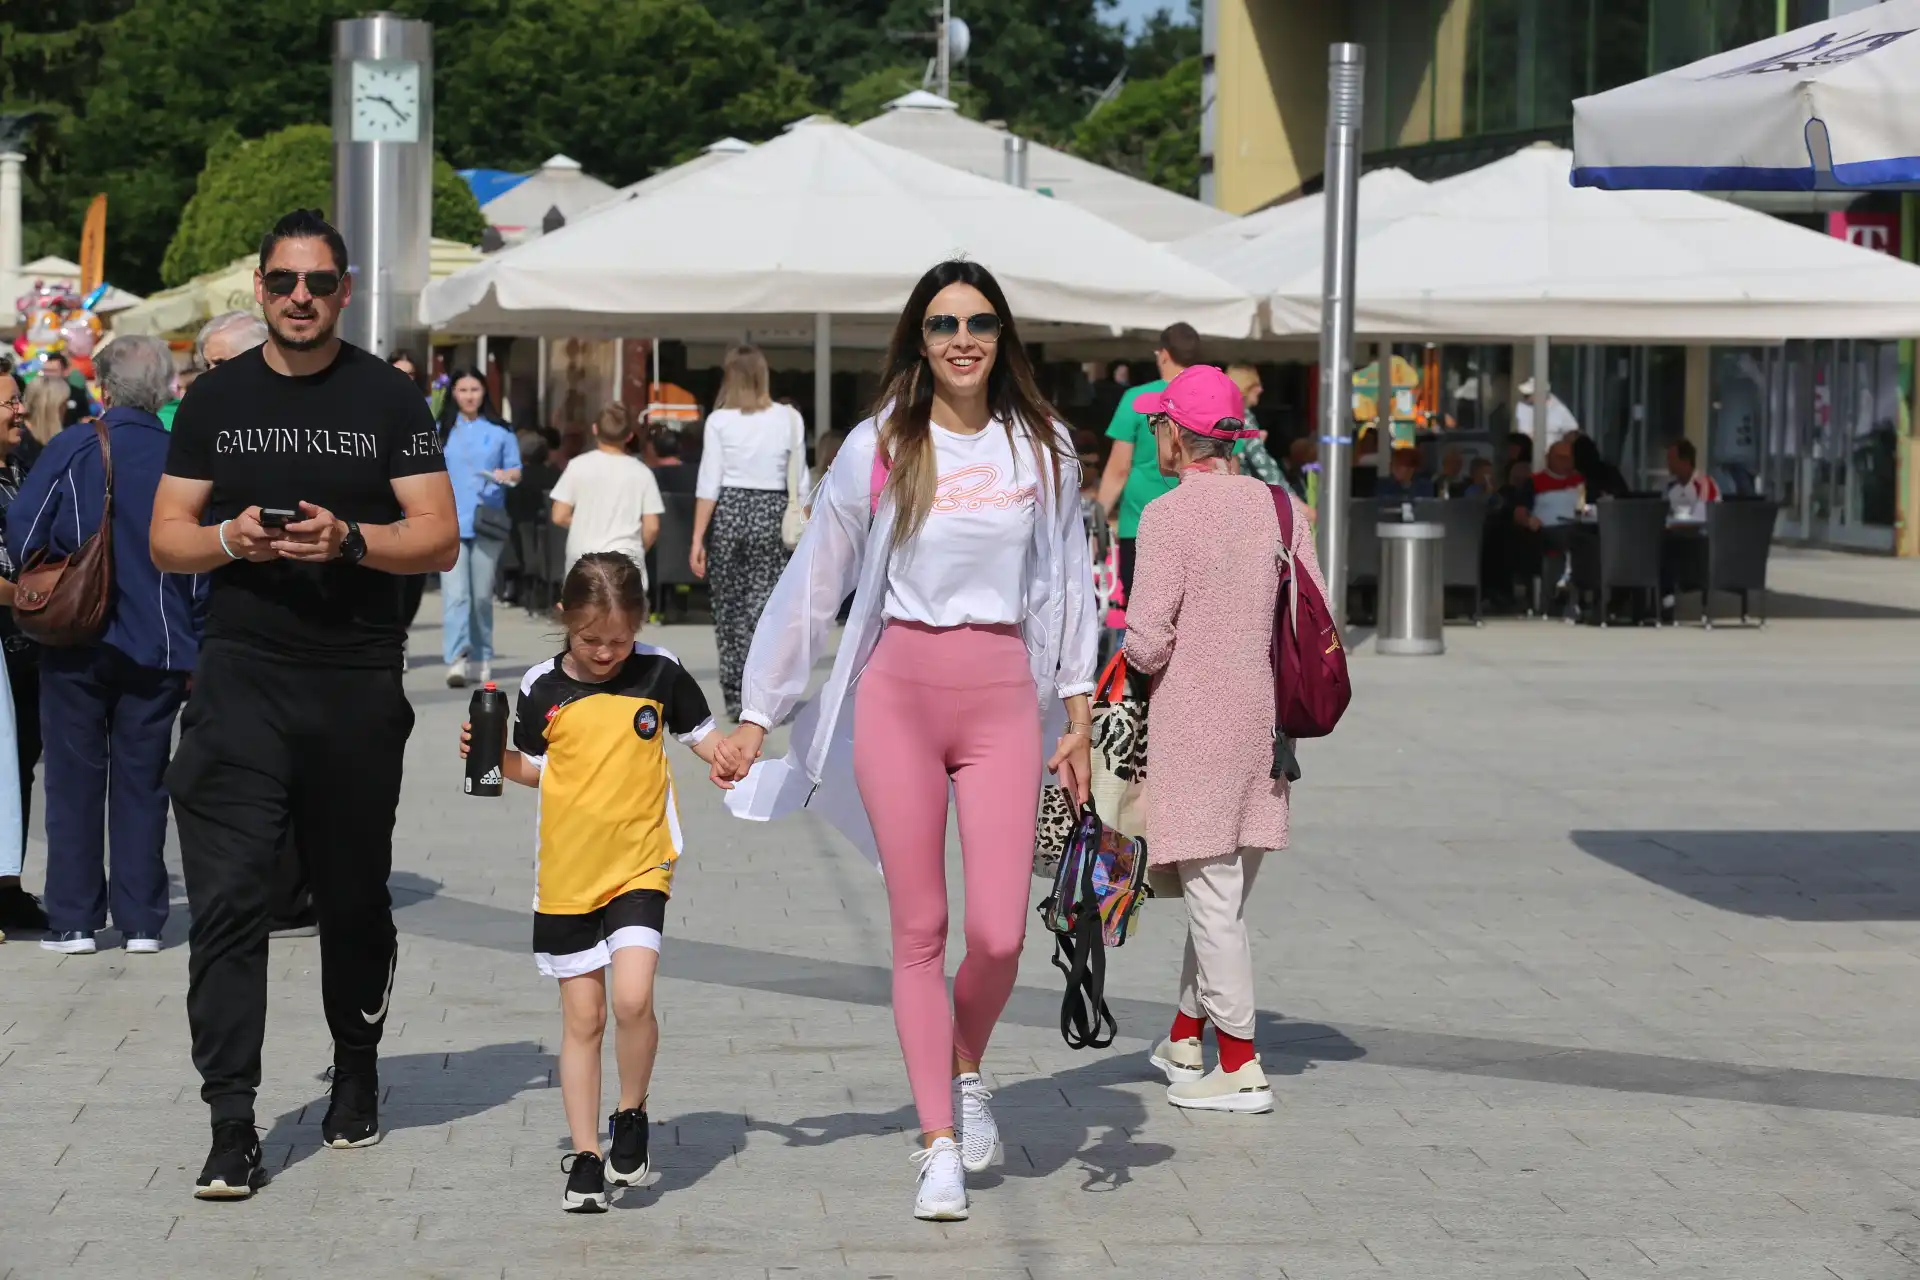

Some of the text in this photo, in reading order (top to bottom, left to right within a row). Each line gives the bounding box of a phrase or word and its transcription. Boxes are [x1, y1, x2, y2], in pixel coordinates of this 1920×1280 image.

[216, 428, 443, 459] CALVIN KLEIN JEA
